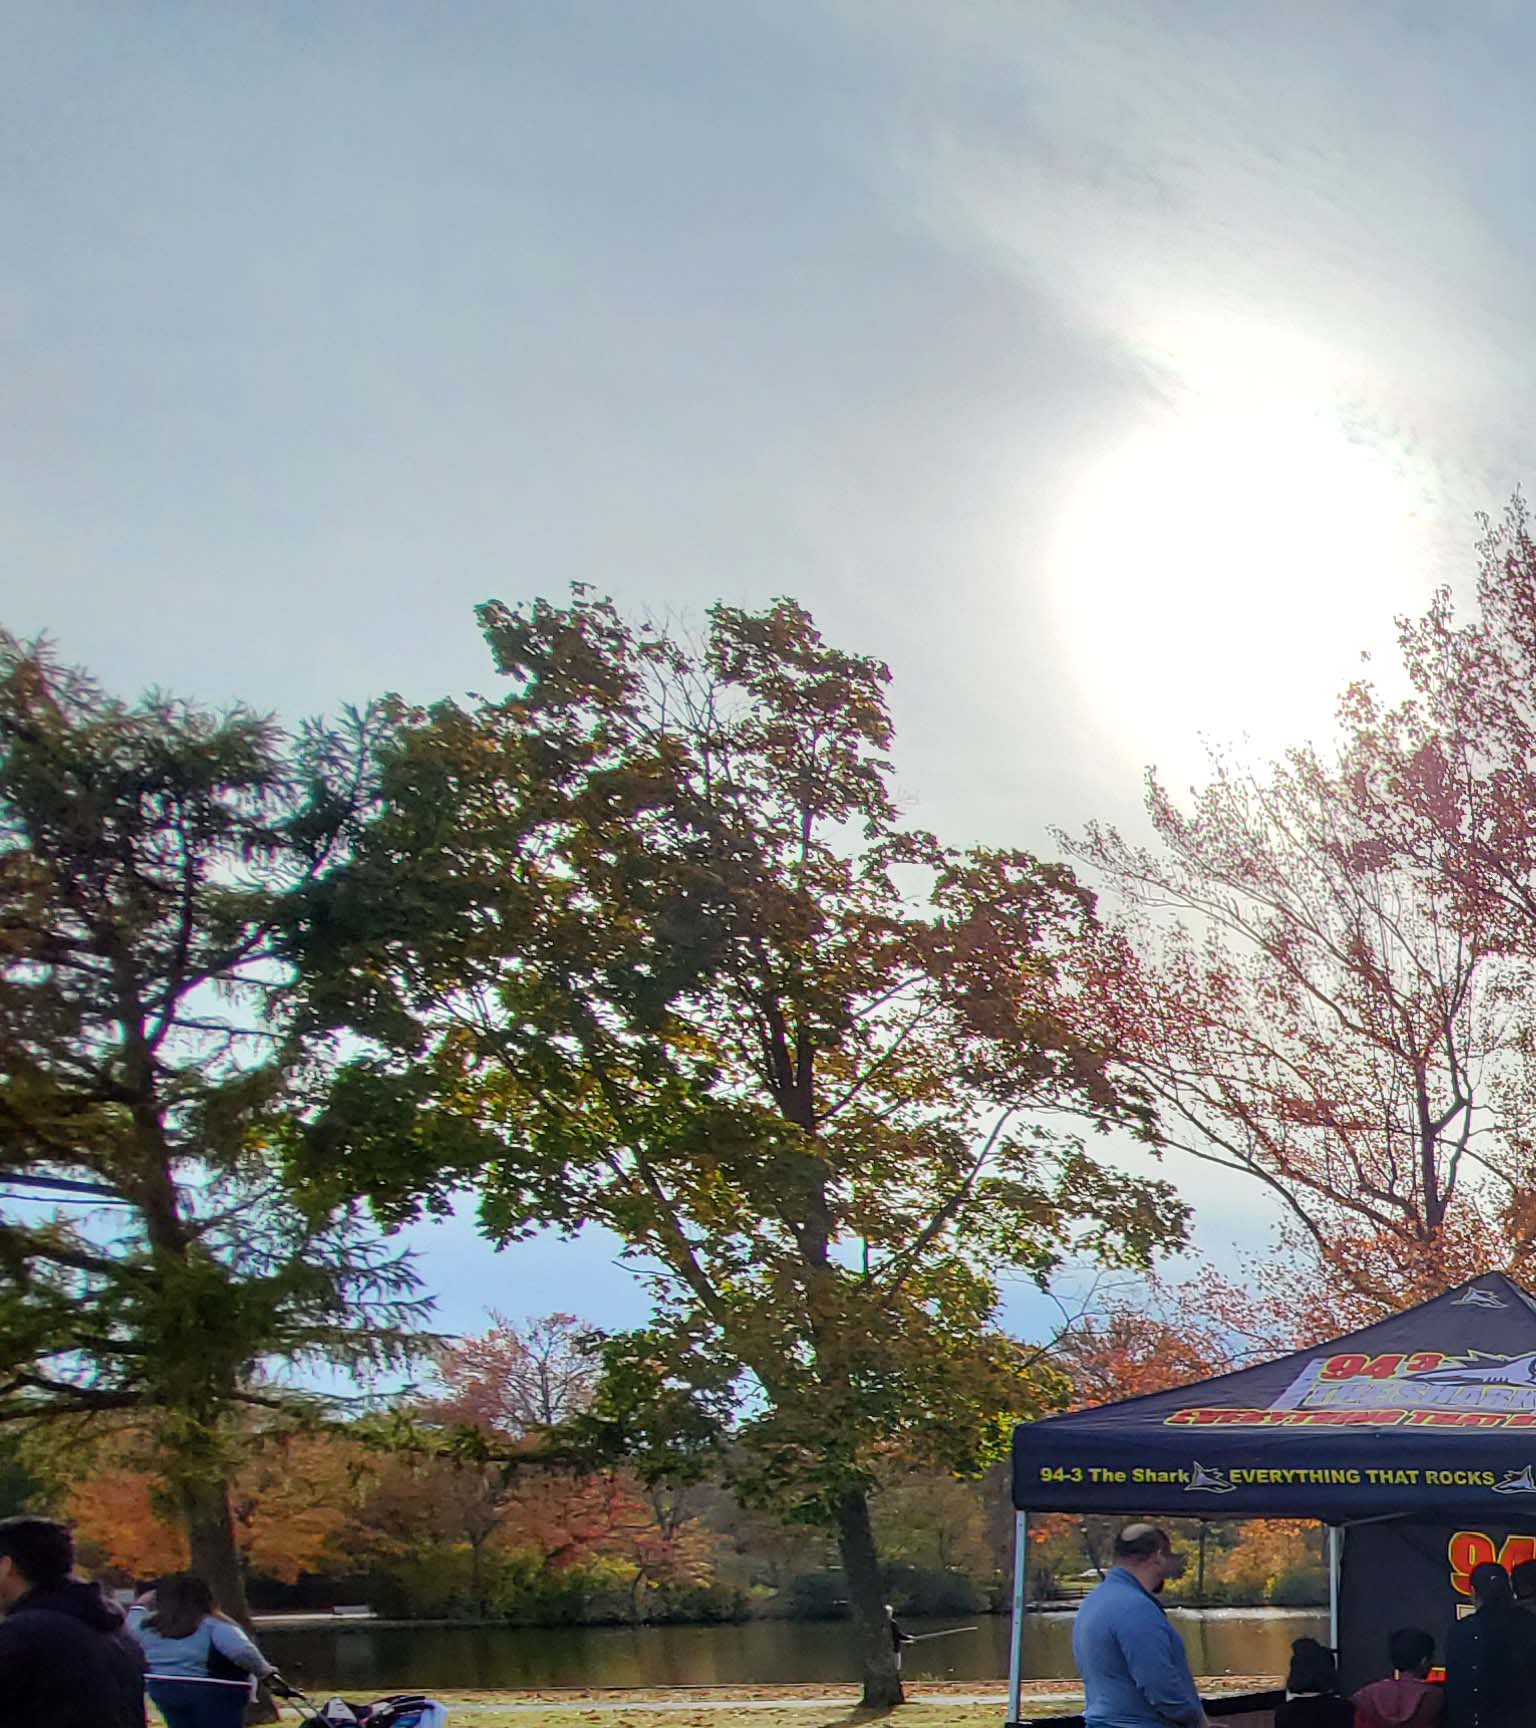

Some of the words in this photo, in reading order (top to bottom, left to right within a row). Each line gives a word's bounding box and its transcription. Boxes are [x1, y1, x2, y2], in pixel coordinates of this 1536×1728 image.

[1040, 1467, 1083, 1483] 94-3
[1088, 1467, 1127, 1483] The
[1132, 1467, 1190, 1484] Shark
[1229, 1468, 1361, 1485] EVERYTHING
[1365, 1469, 1420, 1485] THAT
[1425, 1470, 1495, 1486] ROCKS
